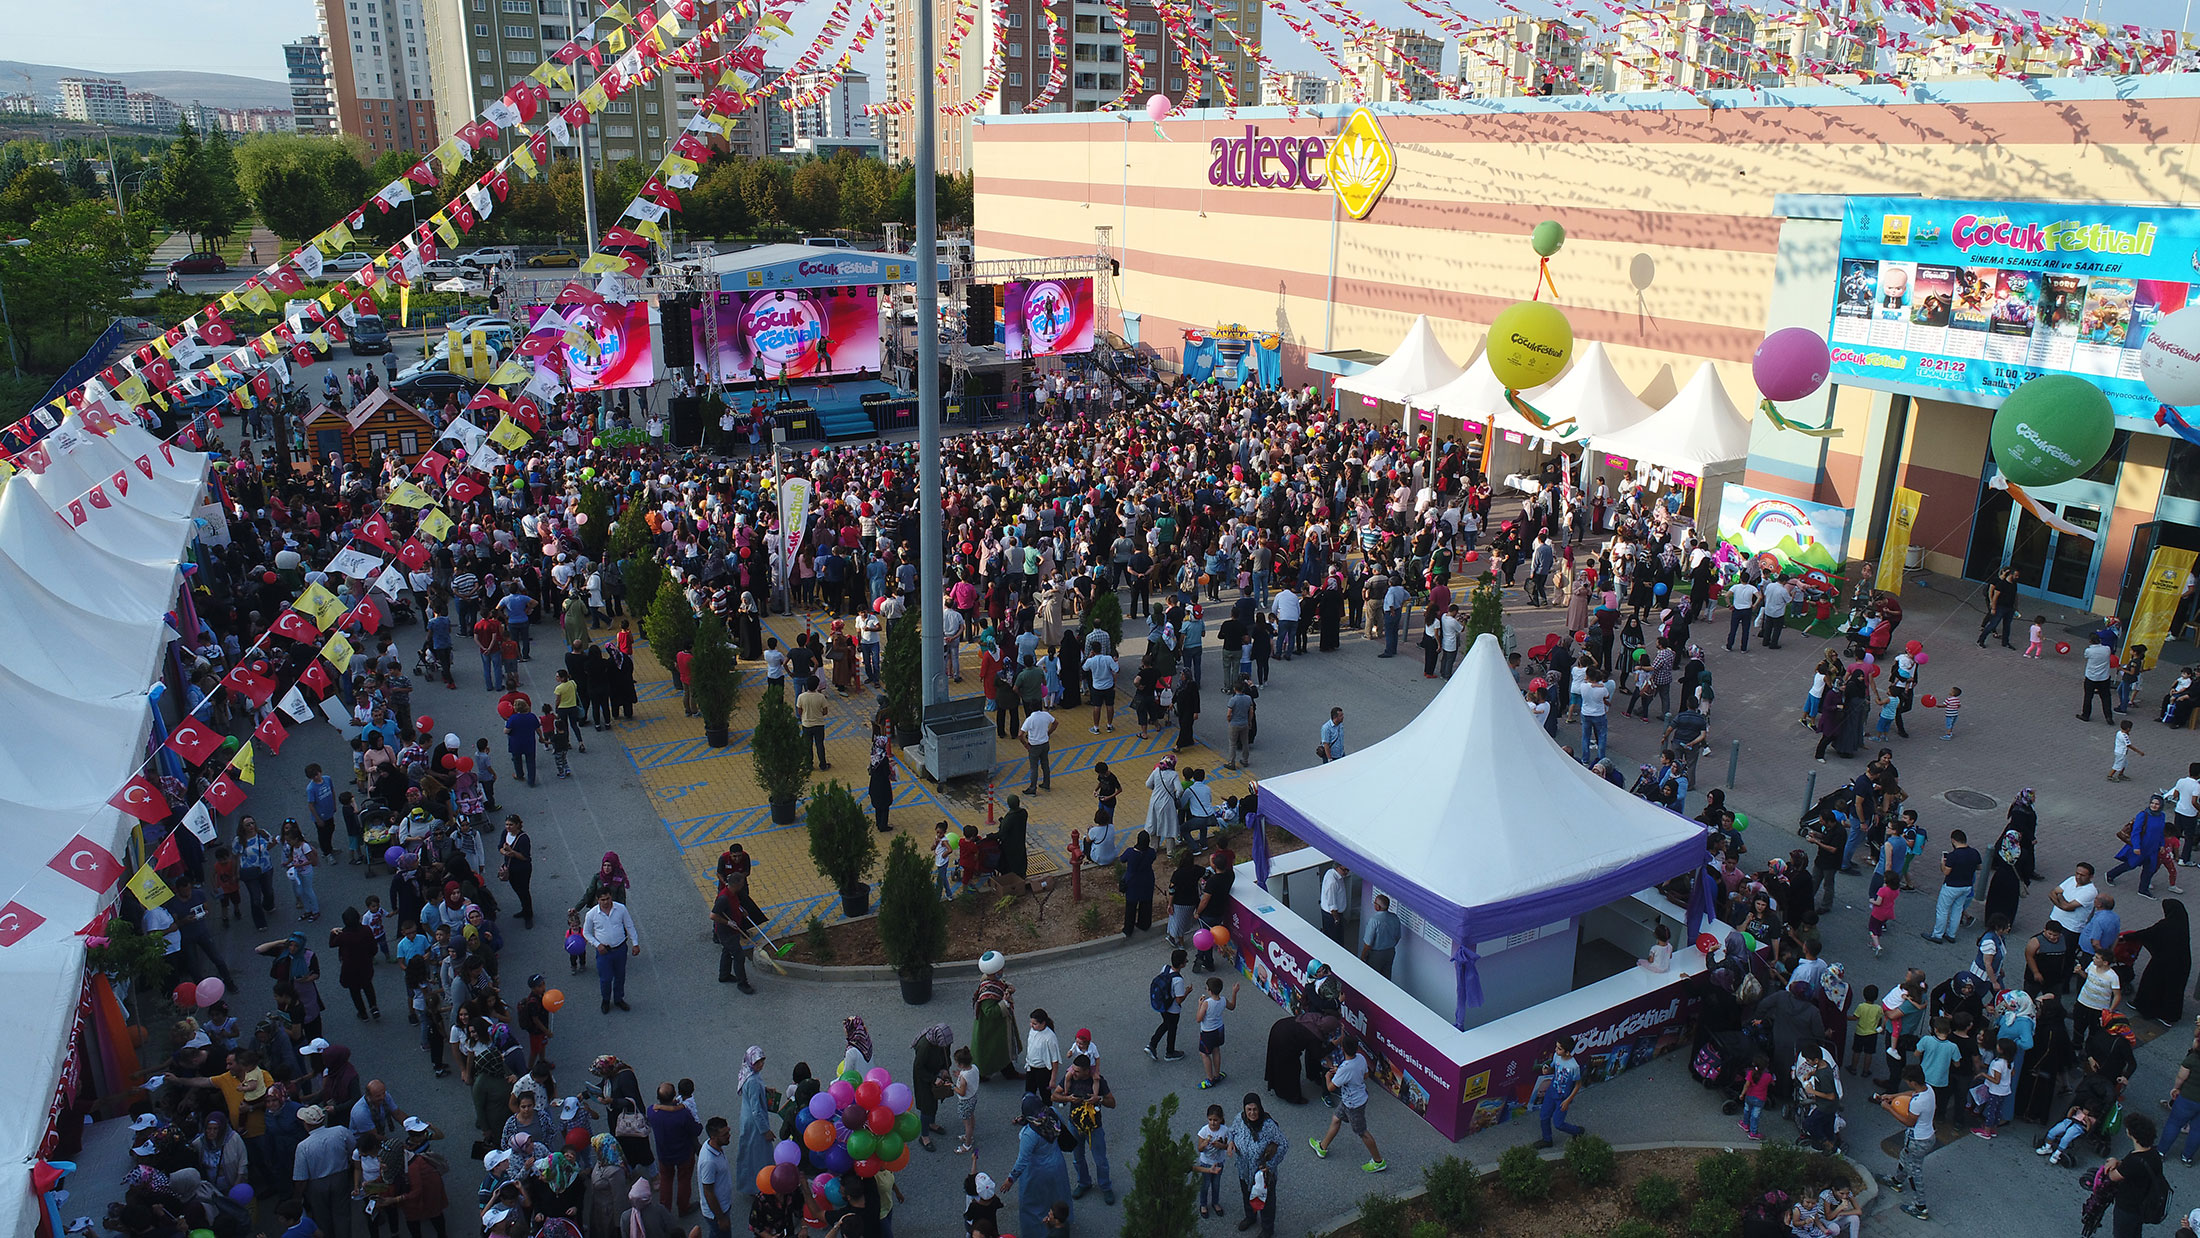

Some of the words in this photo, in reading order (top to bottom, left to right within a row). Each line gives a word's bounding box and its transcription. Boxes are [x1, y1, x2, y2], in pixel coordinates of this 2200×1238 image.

[1208, 125, 1327, 189] adese
[1952, 214, 2045, 254] Çocuk
[2044, 221, 2157, 256] Festivali
[799, 261, 839, 278] Çocuk
[837, 260, 879, 275] Festivali
[1970, 254, 2004, 265] SİNEMA
[2006, 257, 2060, 269] SEANSLARI
[2061, 261, 2072, 269] ve
[2074, 261, 2123, 273] SAATLERİ
[2053, 280, 2076, 289] DORU
[741, 307, 805, 338] Çocuk
[755, 320, 821, 352] Festivali
[1511, 333, 1537, 352] Çocuk
[1536, 344, 1563, 358] Festivali
[1831, 347, 1866, 366] Çocuk
[1865, 352, 1907, 370] Festivali
[1919, 358, 1966, 372] 20-21-22
[1982, 377, 2016, 390] Saatleri
[2015, 422, 2048, 451] Çocuk
[1765, 517, 1792, 529] HATIRASI
[1268, 941, 1308, 988] Çocu
[1618, 998, 1680, 1038] Festivali
[1424, 1066, 1451, 1090] Filmler
